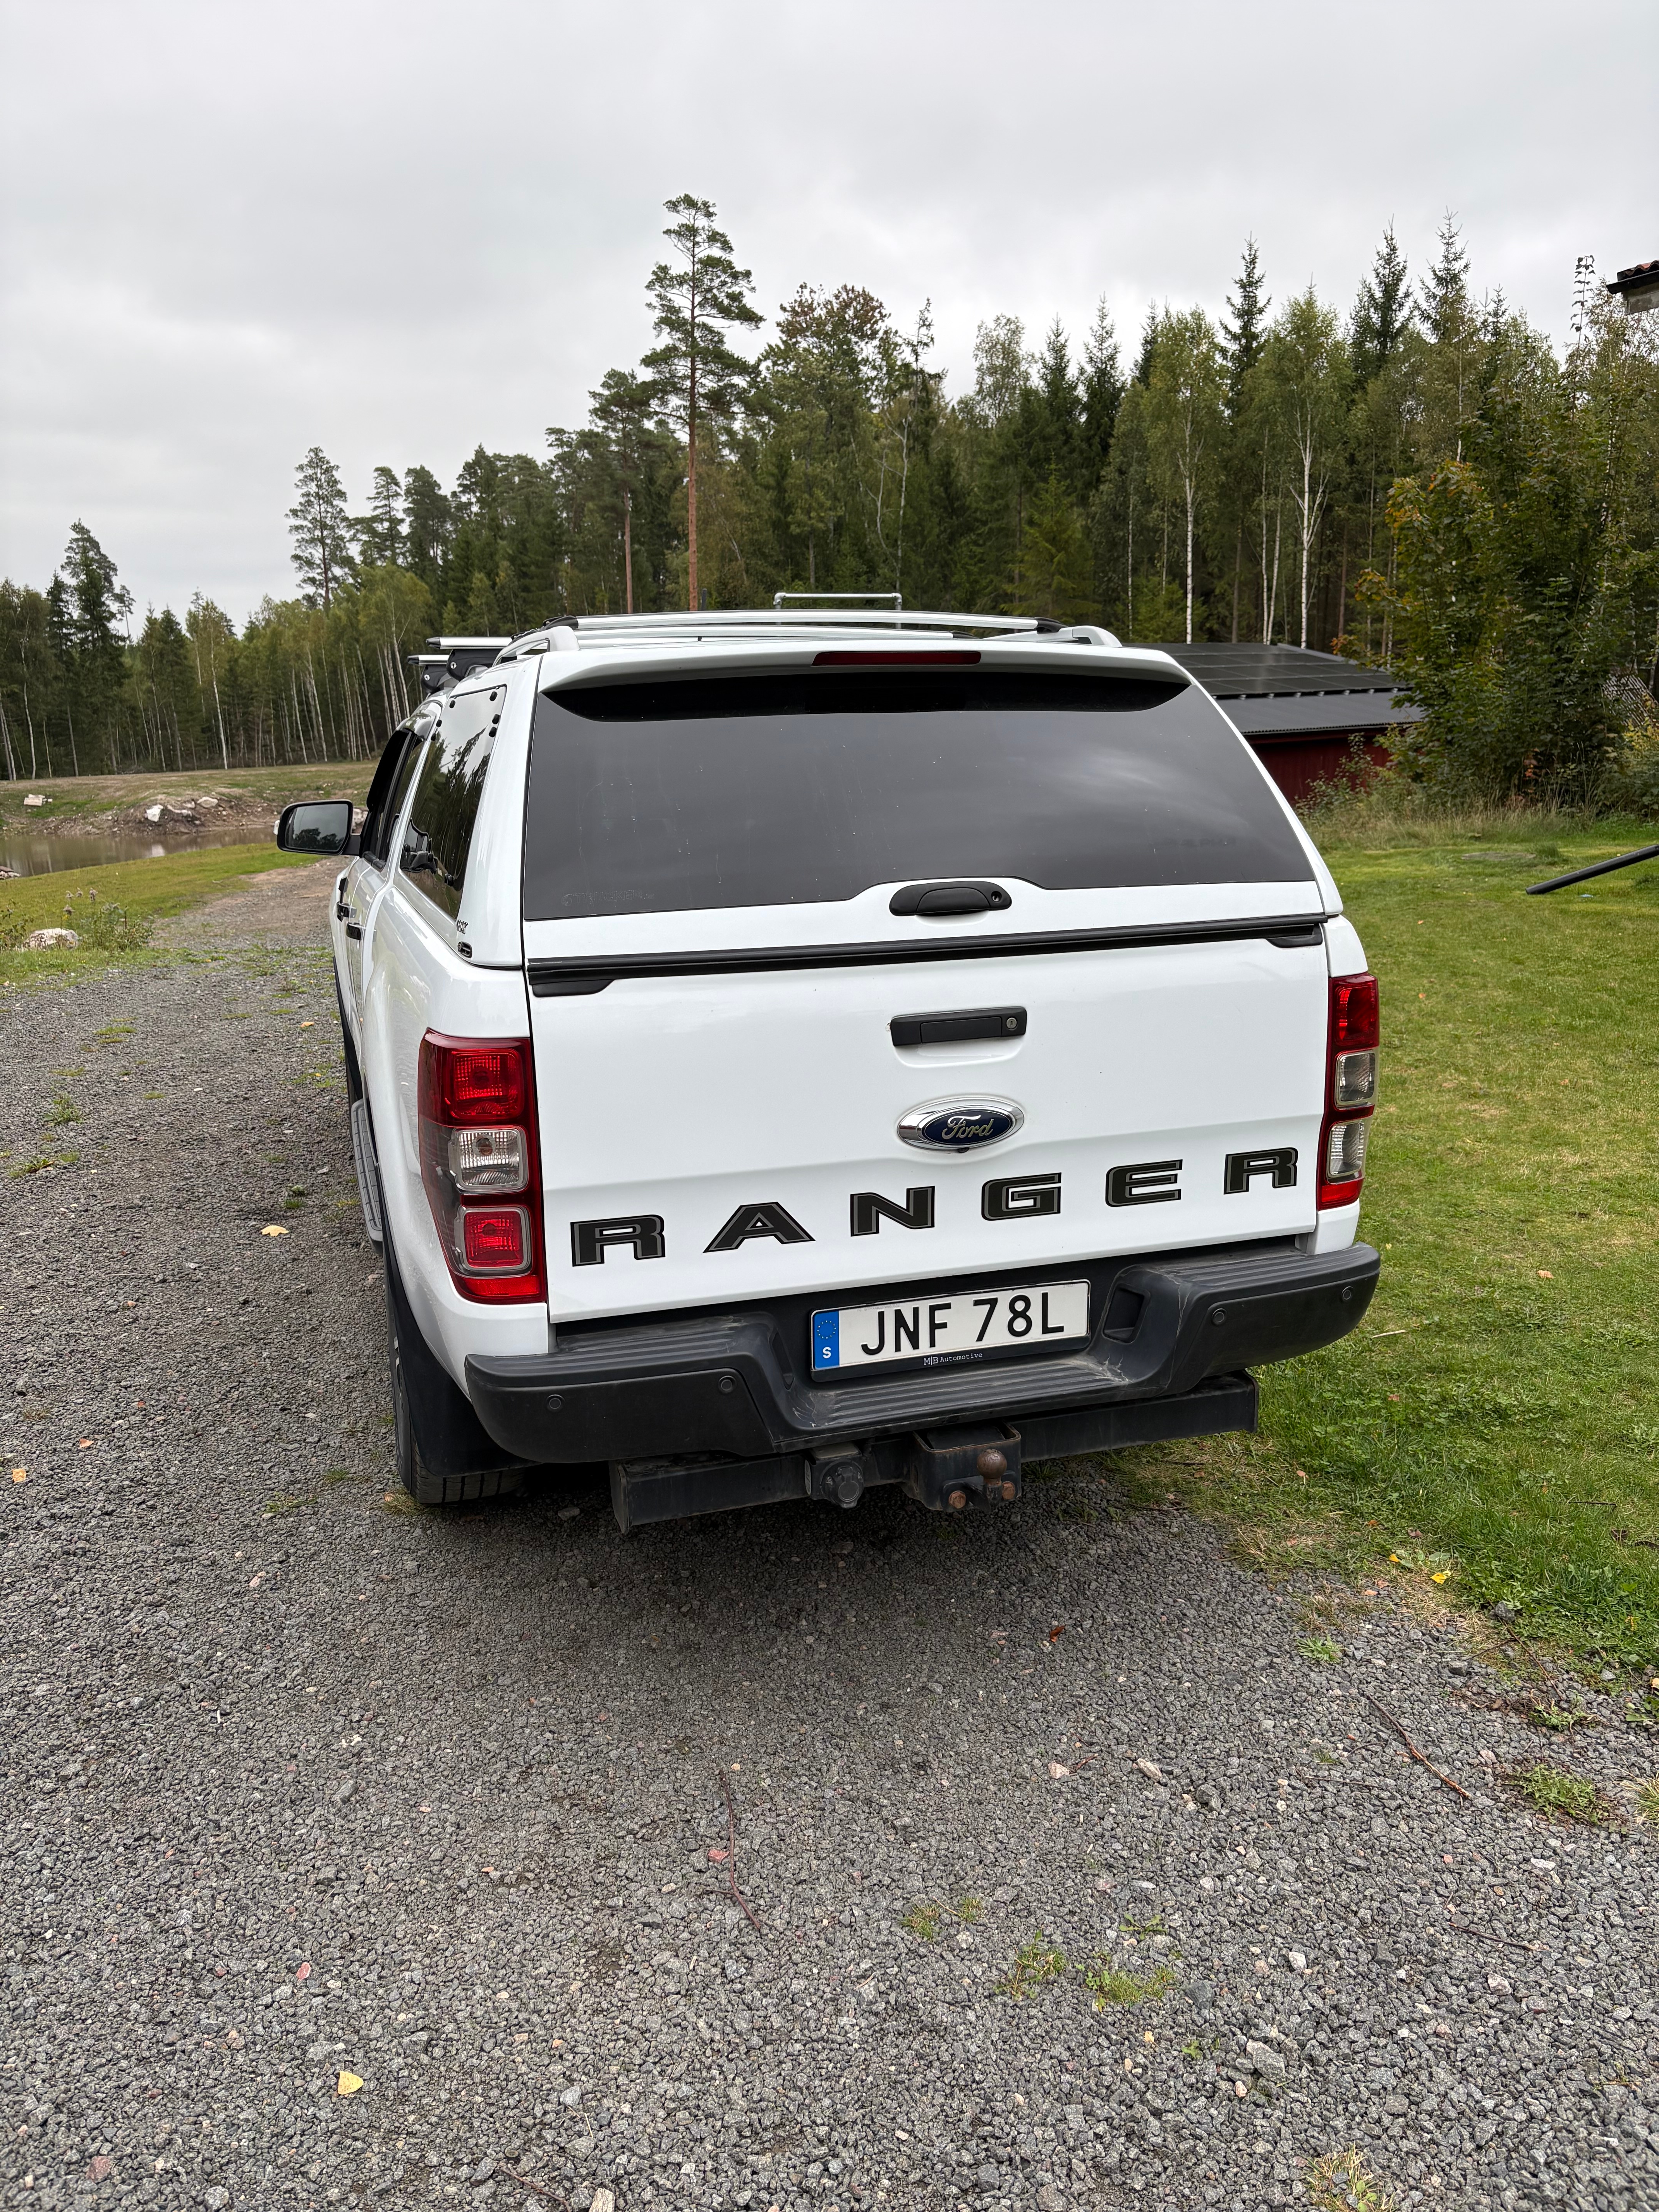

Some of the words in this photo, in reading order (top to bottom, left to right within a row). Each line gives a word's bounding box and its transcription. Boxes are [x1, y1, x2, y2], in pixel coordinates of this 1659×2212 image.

[941, 1115, 994, 1140] Ford
[570, 1147, 1298, 1267] RANGER
[861, 1302, 951, 1355] JNF
[973, 1292, 1064, 1341] 78L
[823, 1346, 831, 1358] S
[940, 1353, 983, 1362] Automotive
